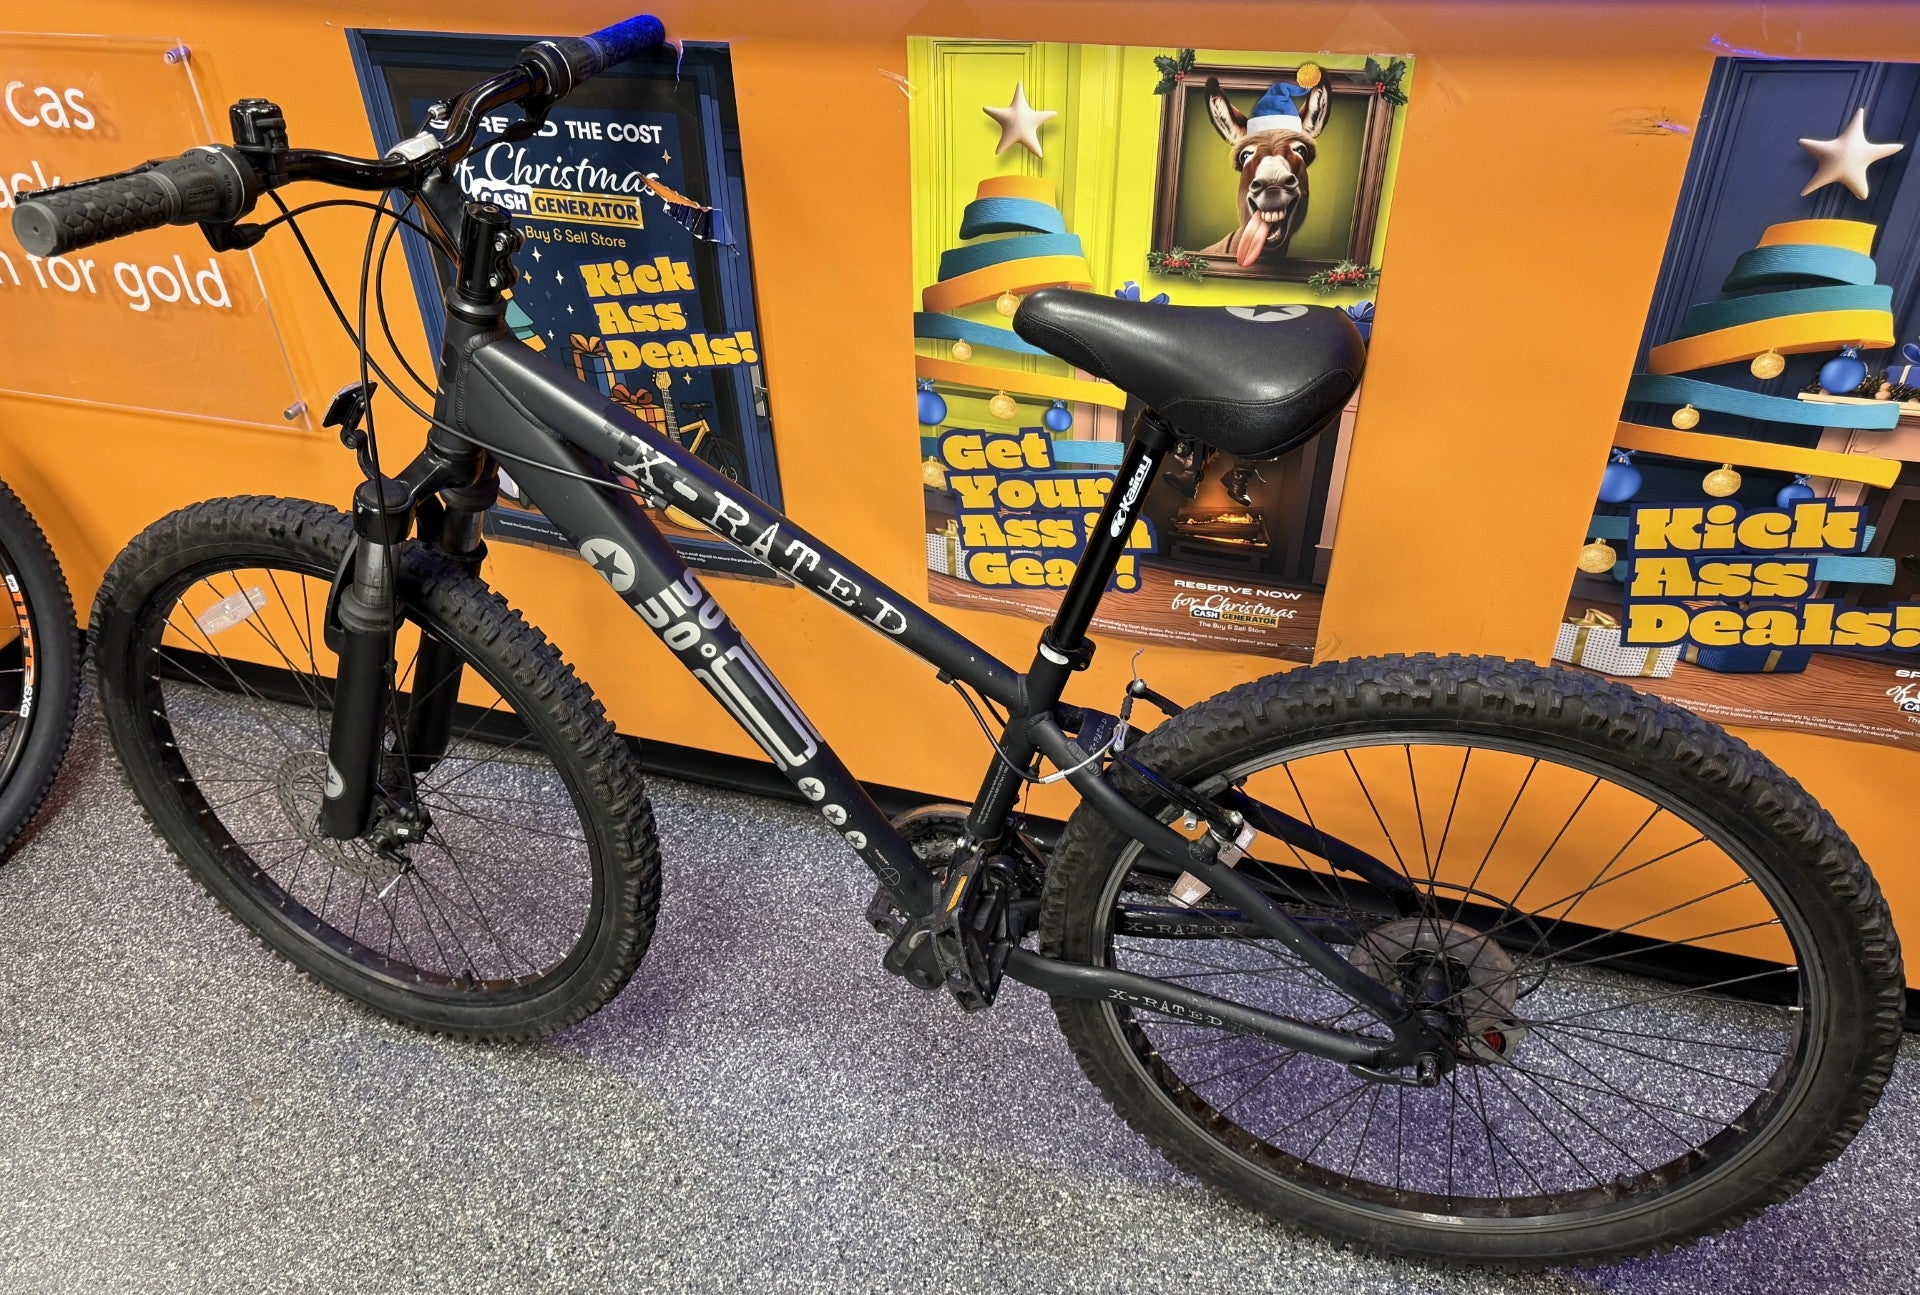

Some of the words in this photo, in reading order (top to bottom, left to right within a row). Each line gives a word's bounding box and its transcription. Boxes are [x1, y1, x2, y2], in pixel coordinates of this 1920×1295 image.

[5, 80, 95, 130] Cas
[564, 121, 602, 141] THE
[606, 123, 662, 144] COST
[485, 142, 660, 197] Christmas
[481, 190, 528, 210] CASH
[535, 196, 639, 222] GENERATOR
[525, 226, 550, 243] Buy
[553, 229, 562, 241] &
[566, 230, 588, 244] Sell
[592, 232, 626, 248] Store
[113, 255, 232, 312] gold
[579, 256, 695, 297] Kick
[593, 301, 687, 335] Ass
[605, 331, 758, 371] Deals!
[942, 433, 1050, 470] Get
[950, 475, 1114, 509] Your
[613, 434, 907, 634] X-RATED
[960, 514, 1077, 548] Ass
[1634, 503, 1860, 550] Kick
[969, 552, 1136, 590] Gea!
[1174, 579, 1252, 595] RESERVE
[1256, 590, 1302, 600] NOW
[1631, 557, 1809, 598] Ass
[1171, 593, 1201, 610] for
[1204, 594, 1297, 619] Christmas
[1193, 609, 1219, 619] CASH
[1222, 612, 1277, 625] GENERATOR
[1198, 620, 1211, 628] The
[1213, 622, 1226, 631] Buy
[1627, 603, 1920, 648] Deals!
[1886, 683, 1916, 704] of
[1108, 988, 1223, 1027] X-RATED
